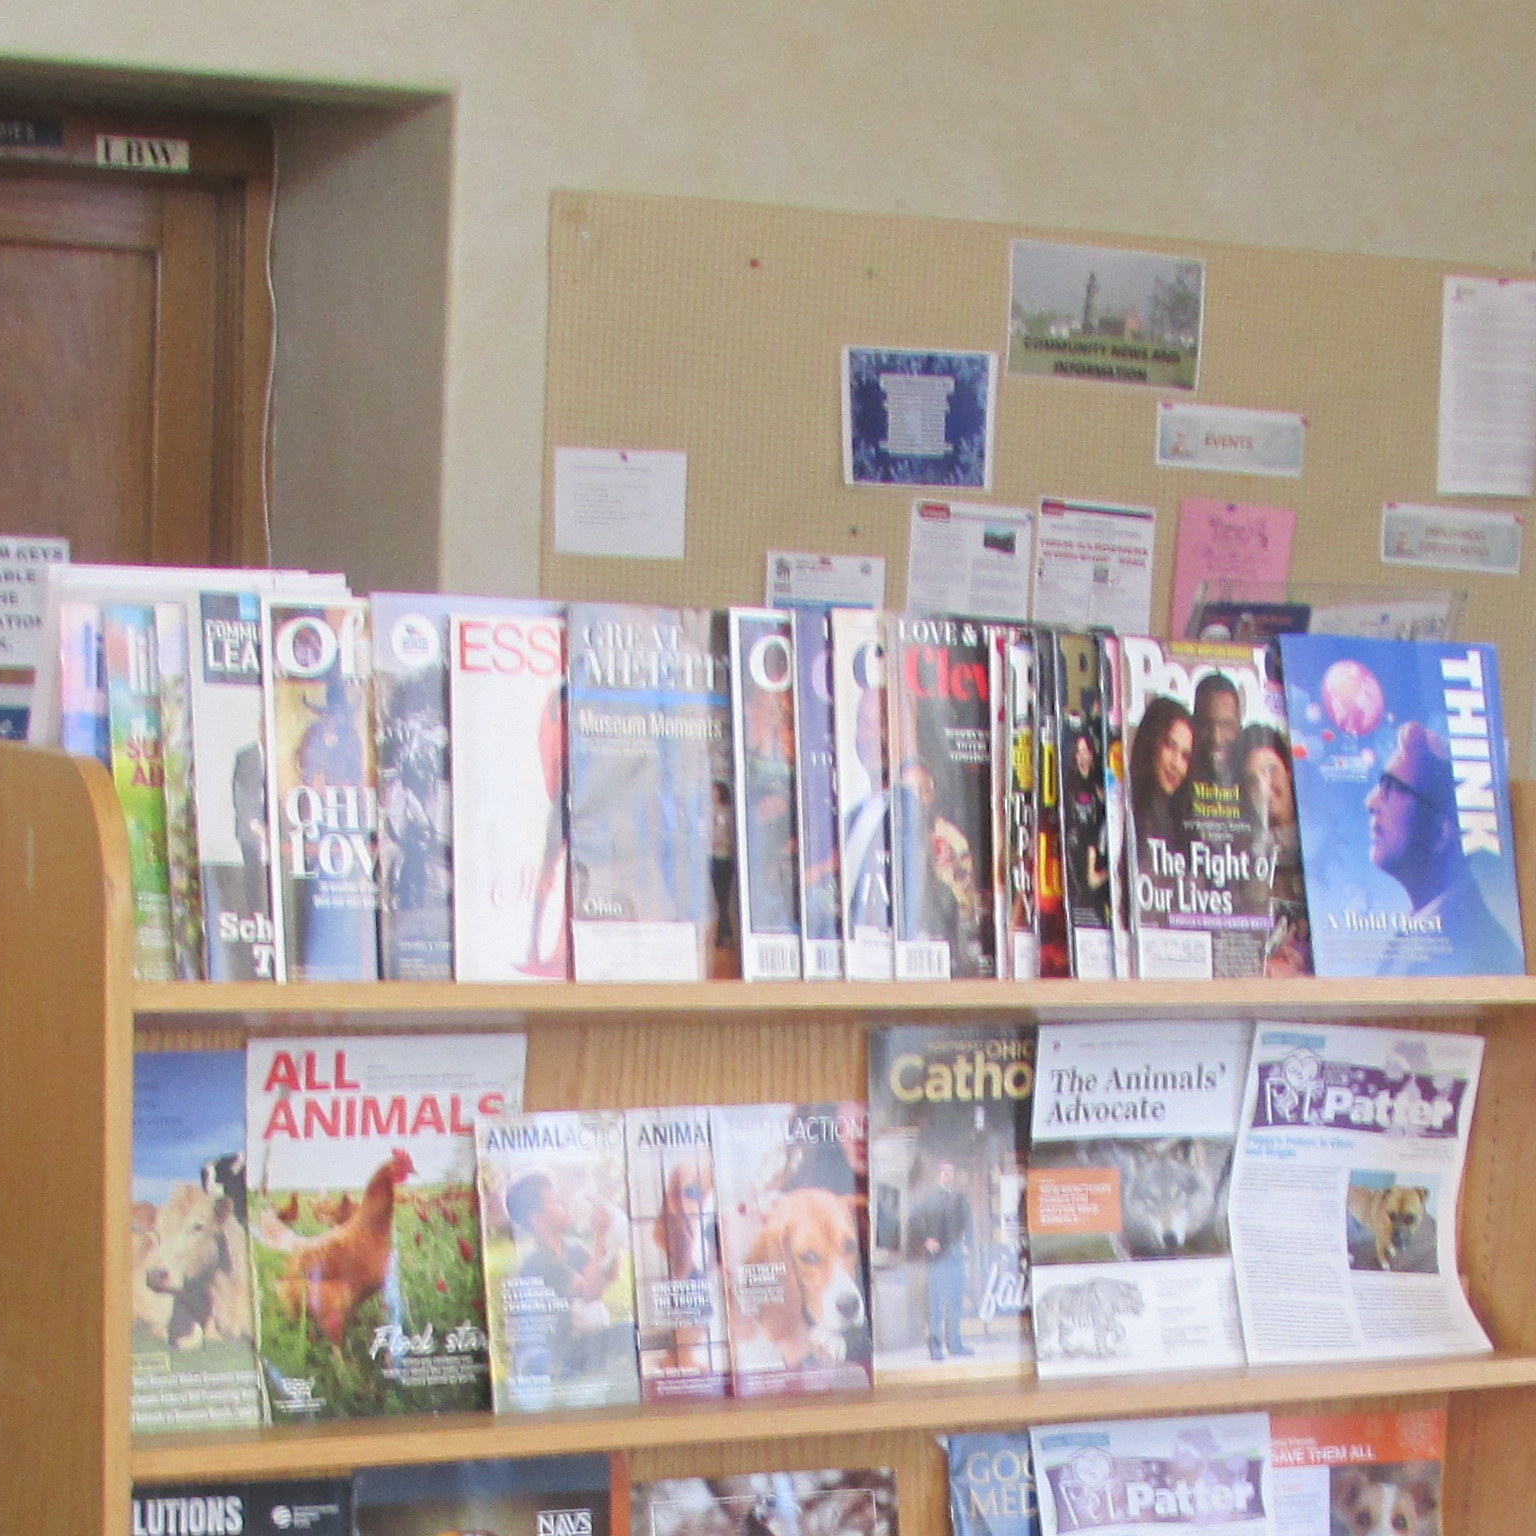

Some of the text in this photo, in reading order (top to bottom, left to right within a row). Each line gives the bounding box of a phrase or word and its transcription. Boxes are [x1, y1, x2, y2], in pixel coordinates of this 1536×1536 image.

[1023, 335, 1107, 355] COMMUNITY
[1110, 344, 1149, 360] NEWS
[1053, 359, 1148, 382] INFORMATION
[1204, 432, 1254, 451] EVENTS
[16, 546, 63, 561] KEYS
[898, 618, 958, 646] LOVE
[459, 621, 568, 678] ESS
[579, 708, 723, 740] Museum Moments
[1439, 649, 1502, 857] THINK
[1192, 781, 1240, 802] Michael
[1192, 801, 1241, 819] Strahan
[1147, 836, 1281, 889] The Fight of
[1136, 873, 1233, 915] Our Lives
[1344, 909, 1388, 932] Bold
[1391, 911, 1443, 935] Quest
[261, 1049, 362, 1093] ALL
[889, 1050, 1033, 1106] Catho
[1050, 1064, 1098, 1094] The
[261, 1091, 506, 1140] ANIMALS
[1045, 1097, 1166, 1127] Advocate
[1309, 1446, 1347, 1462] THEM
